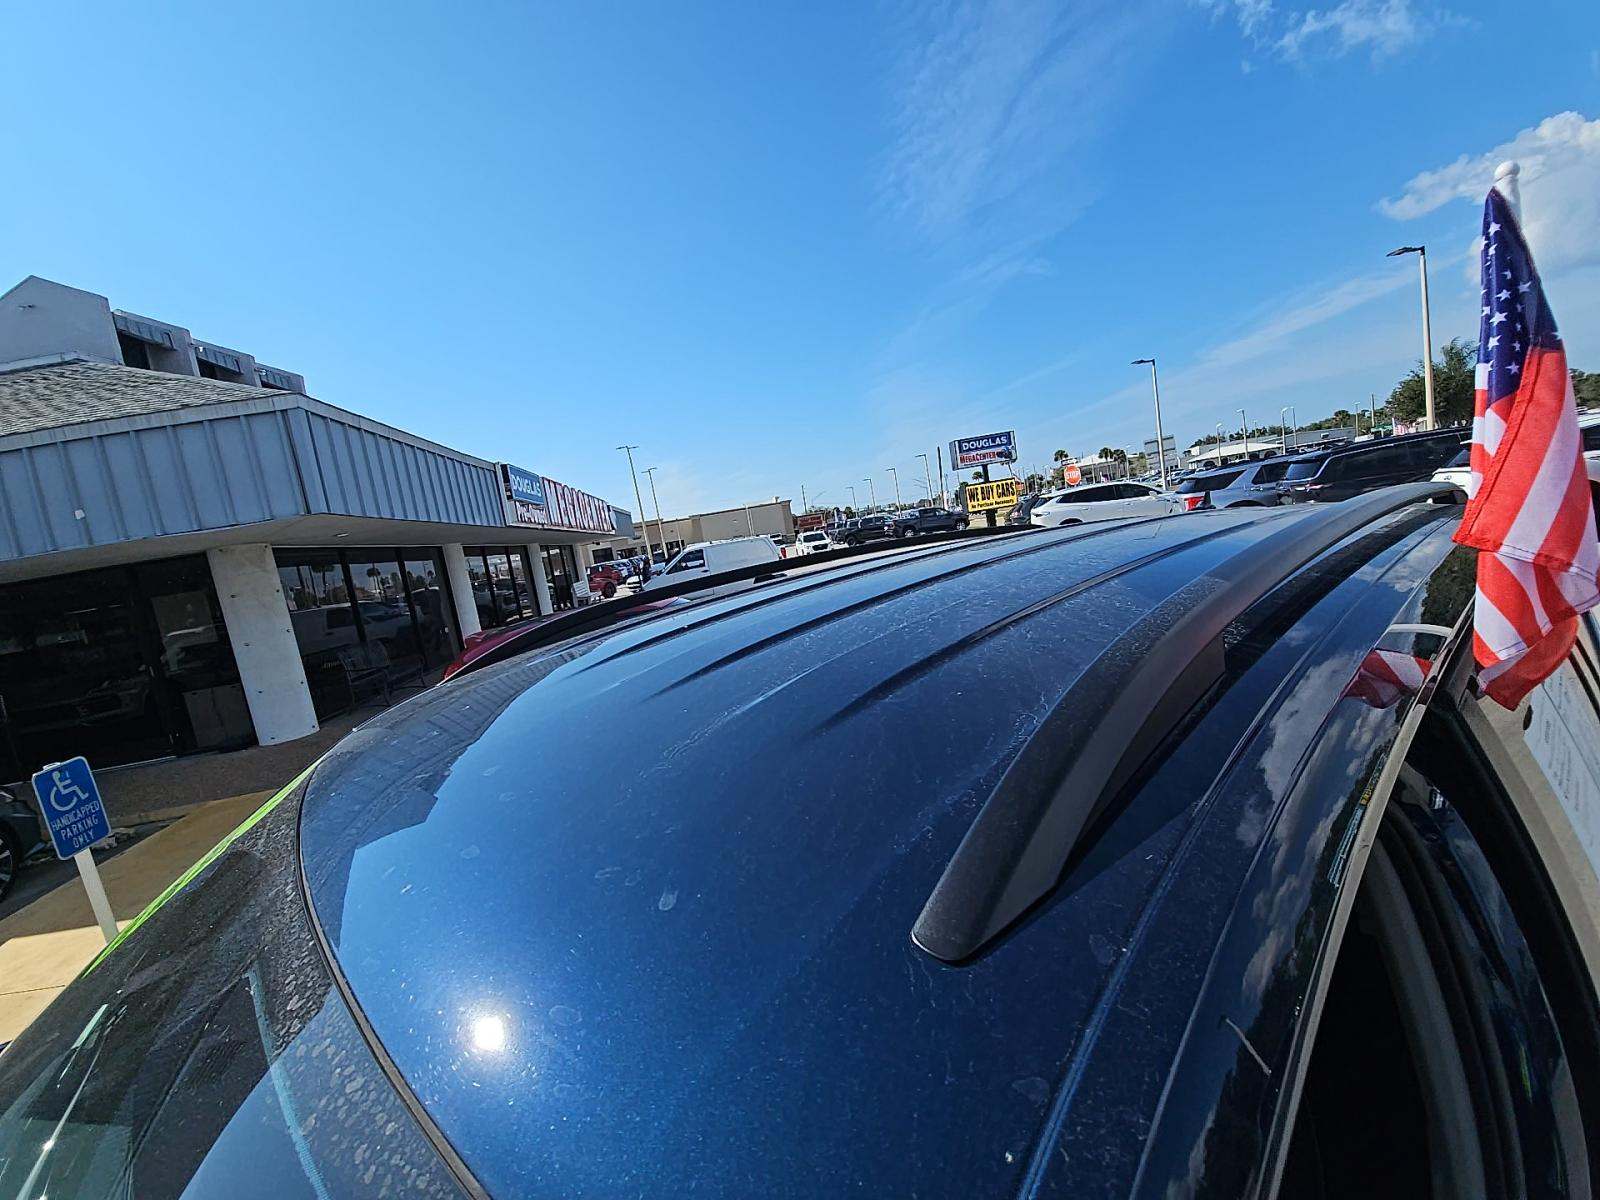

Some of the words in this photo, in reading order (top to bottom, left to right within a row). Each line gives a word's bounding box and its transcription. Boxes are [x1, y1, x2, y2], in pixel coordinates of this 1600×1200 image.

[962, 436, 1007, 450] DOUGLAS
[511, 474, 541, 497] DOUGLAS
[967, 487, 979, 502] WE
[981, 485, 995, 500] BUY
[996, 482, 1015, 498] CARS
[50, 800, 99, 832] HANDICAPPED
[61, 815, 98, 841] PARKING
[73, 829, 95, 848] ONLY
